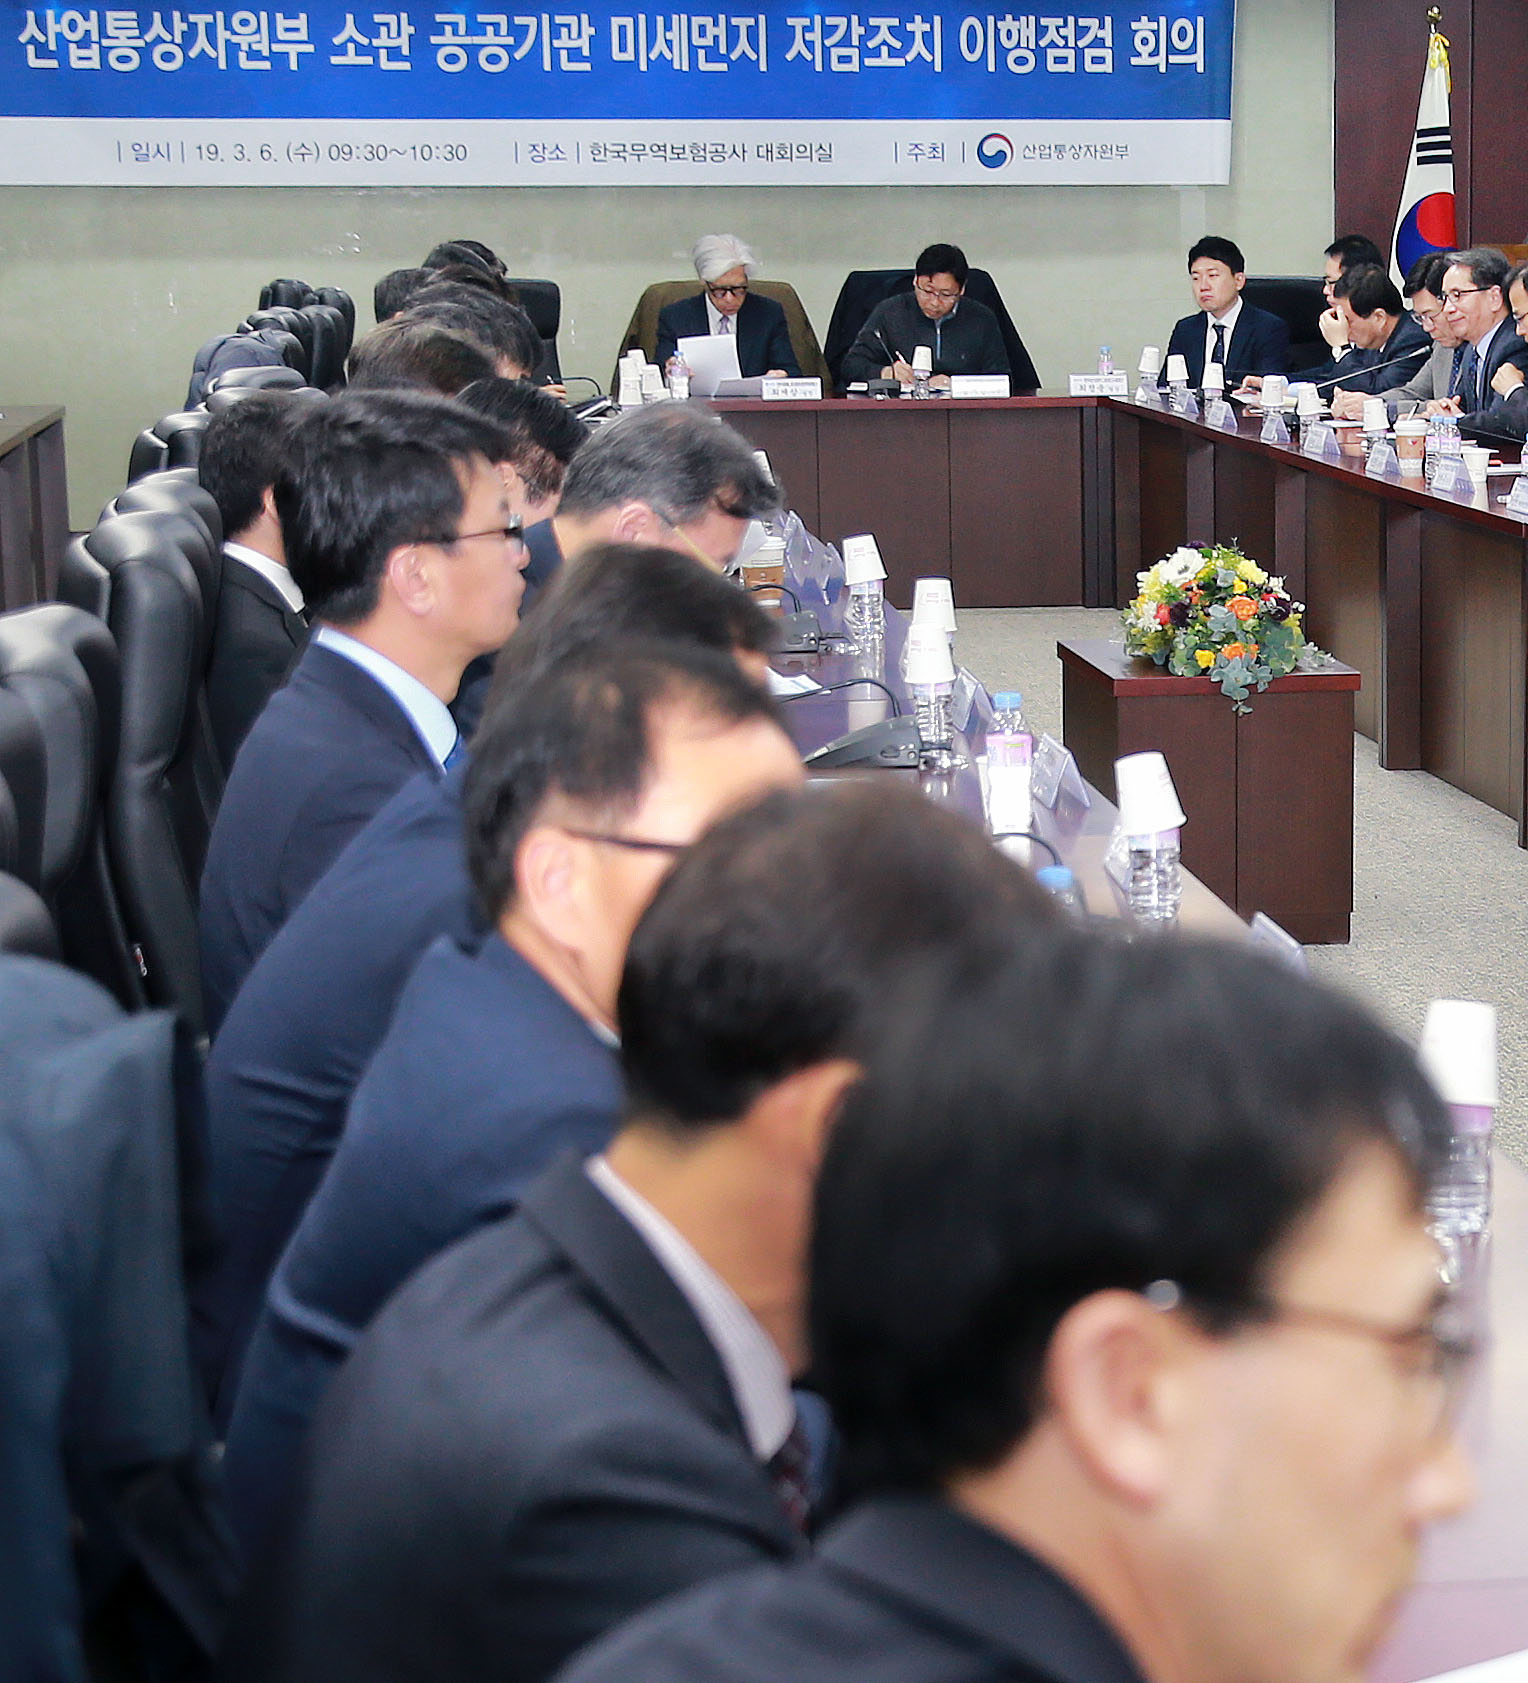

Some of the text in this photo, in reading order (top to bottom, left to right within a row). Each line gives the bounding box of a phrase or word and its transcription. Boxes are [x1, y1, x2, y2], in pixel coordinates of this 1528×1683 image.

[17, 9, 1205, 73] 산업통상자원부 소관 공공기관 미세먼지 저감조치 이행점검 회의
[130, 141, 467, 163] 일시 19. 3. 6. (수) 09:30~10:30
[527, 142, 833, 163] 장소 한국무역보험공사 대회의실
[907, 142, 1129, 162] 주최 산업통상자원부
